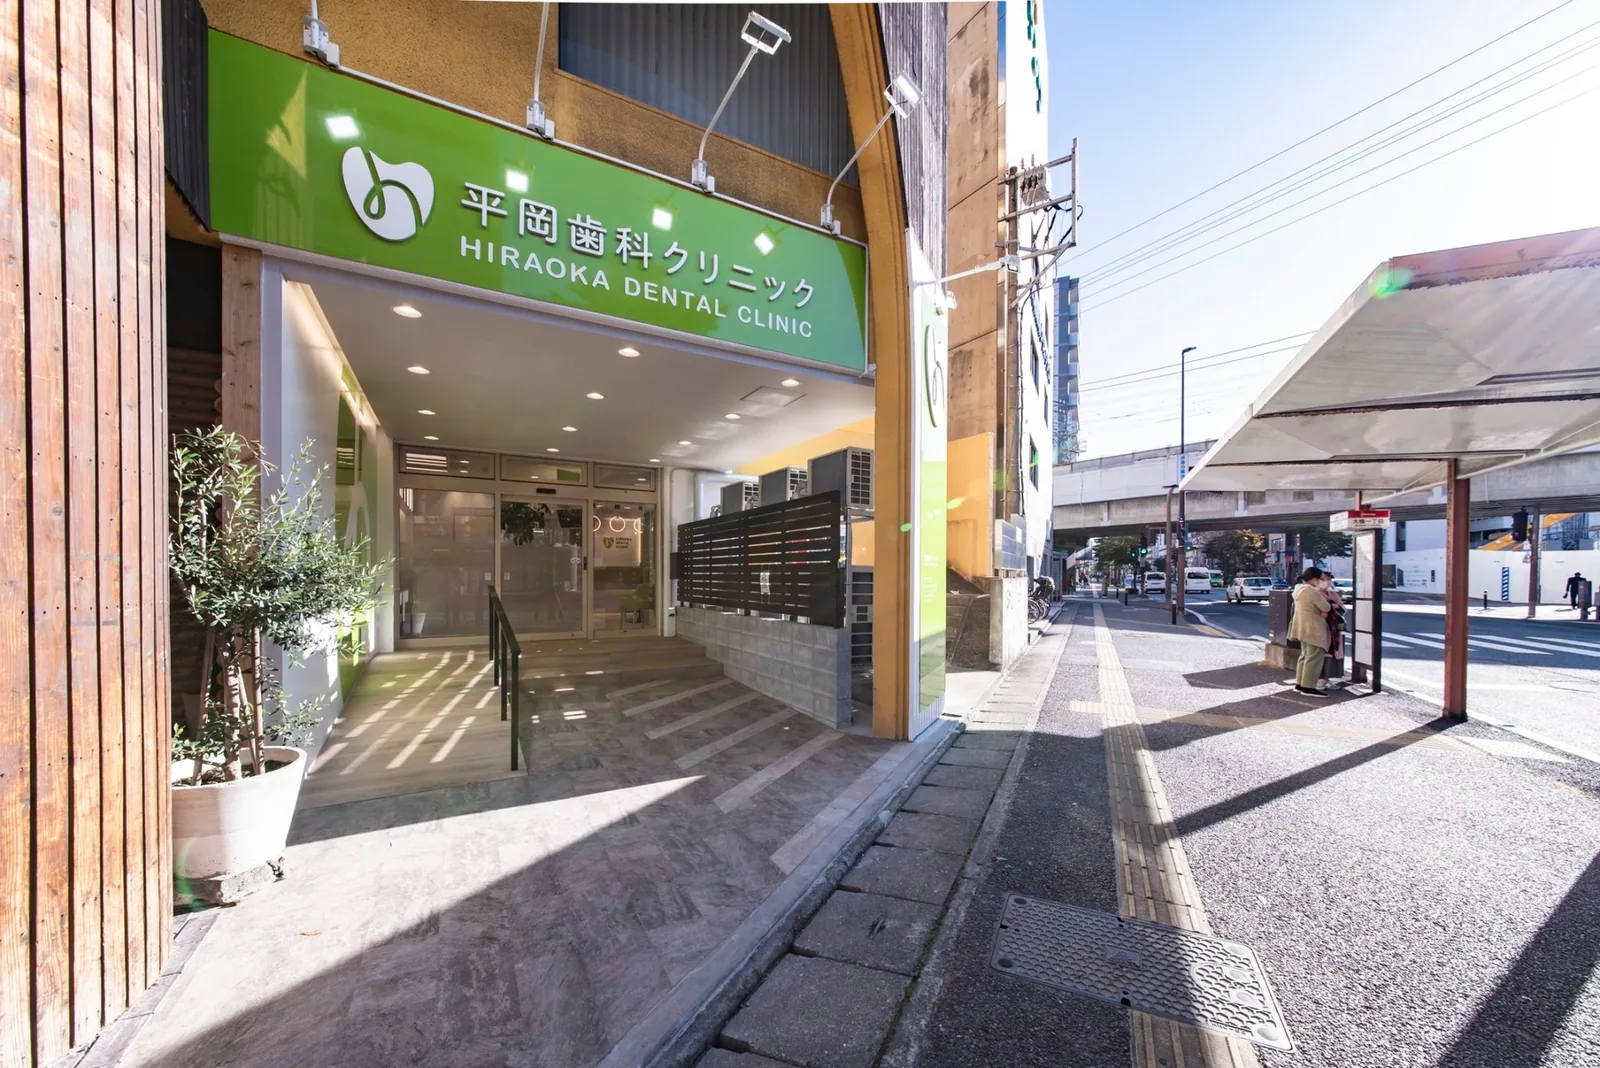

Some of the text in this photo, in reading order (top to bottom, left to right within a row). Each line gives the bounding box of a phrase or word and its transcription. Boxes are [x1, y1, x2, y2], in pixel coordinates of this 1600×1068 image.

[461, 182, 814, 308] 平岡歯科クリニック
[461, 235, 812, 338] HIRAOKA DENTAL CLINIC
